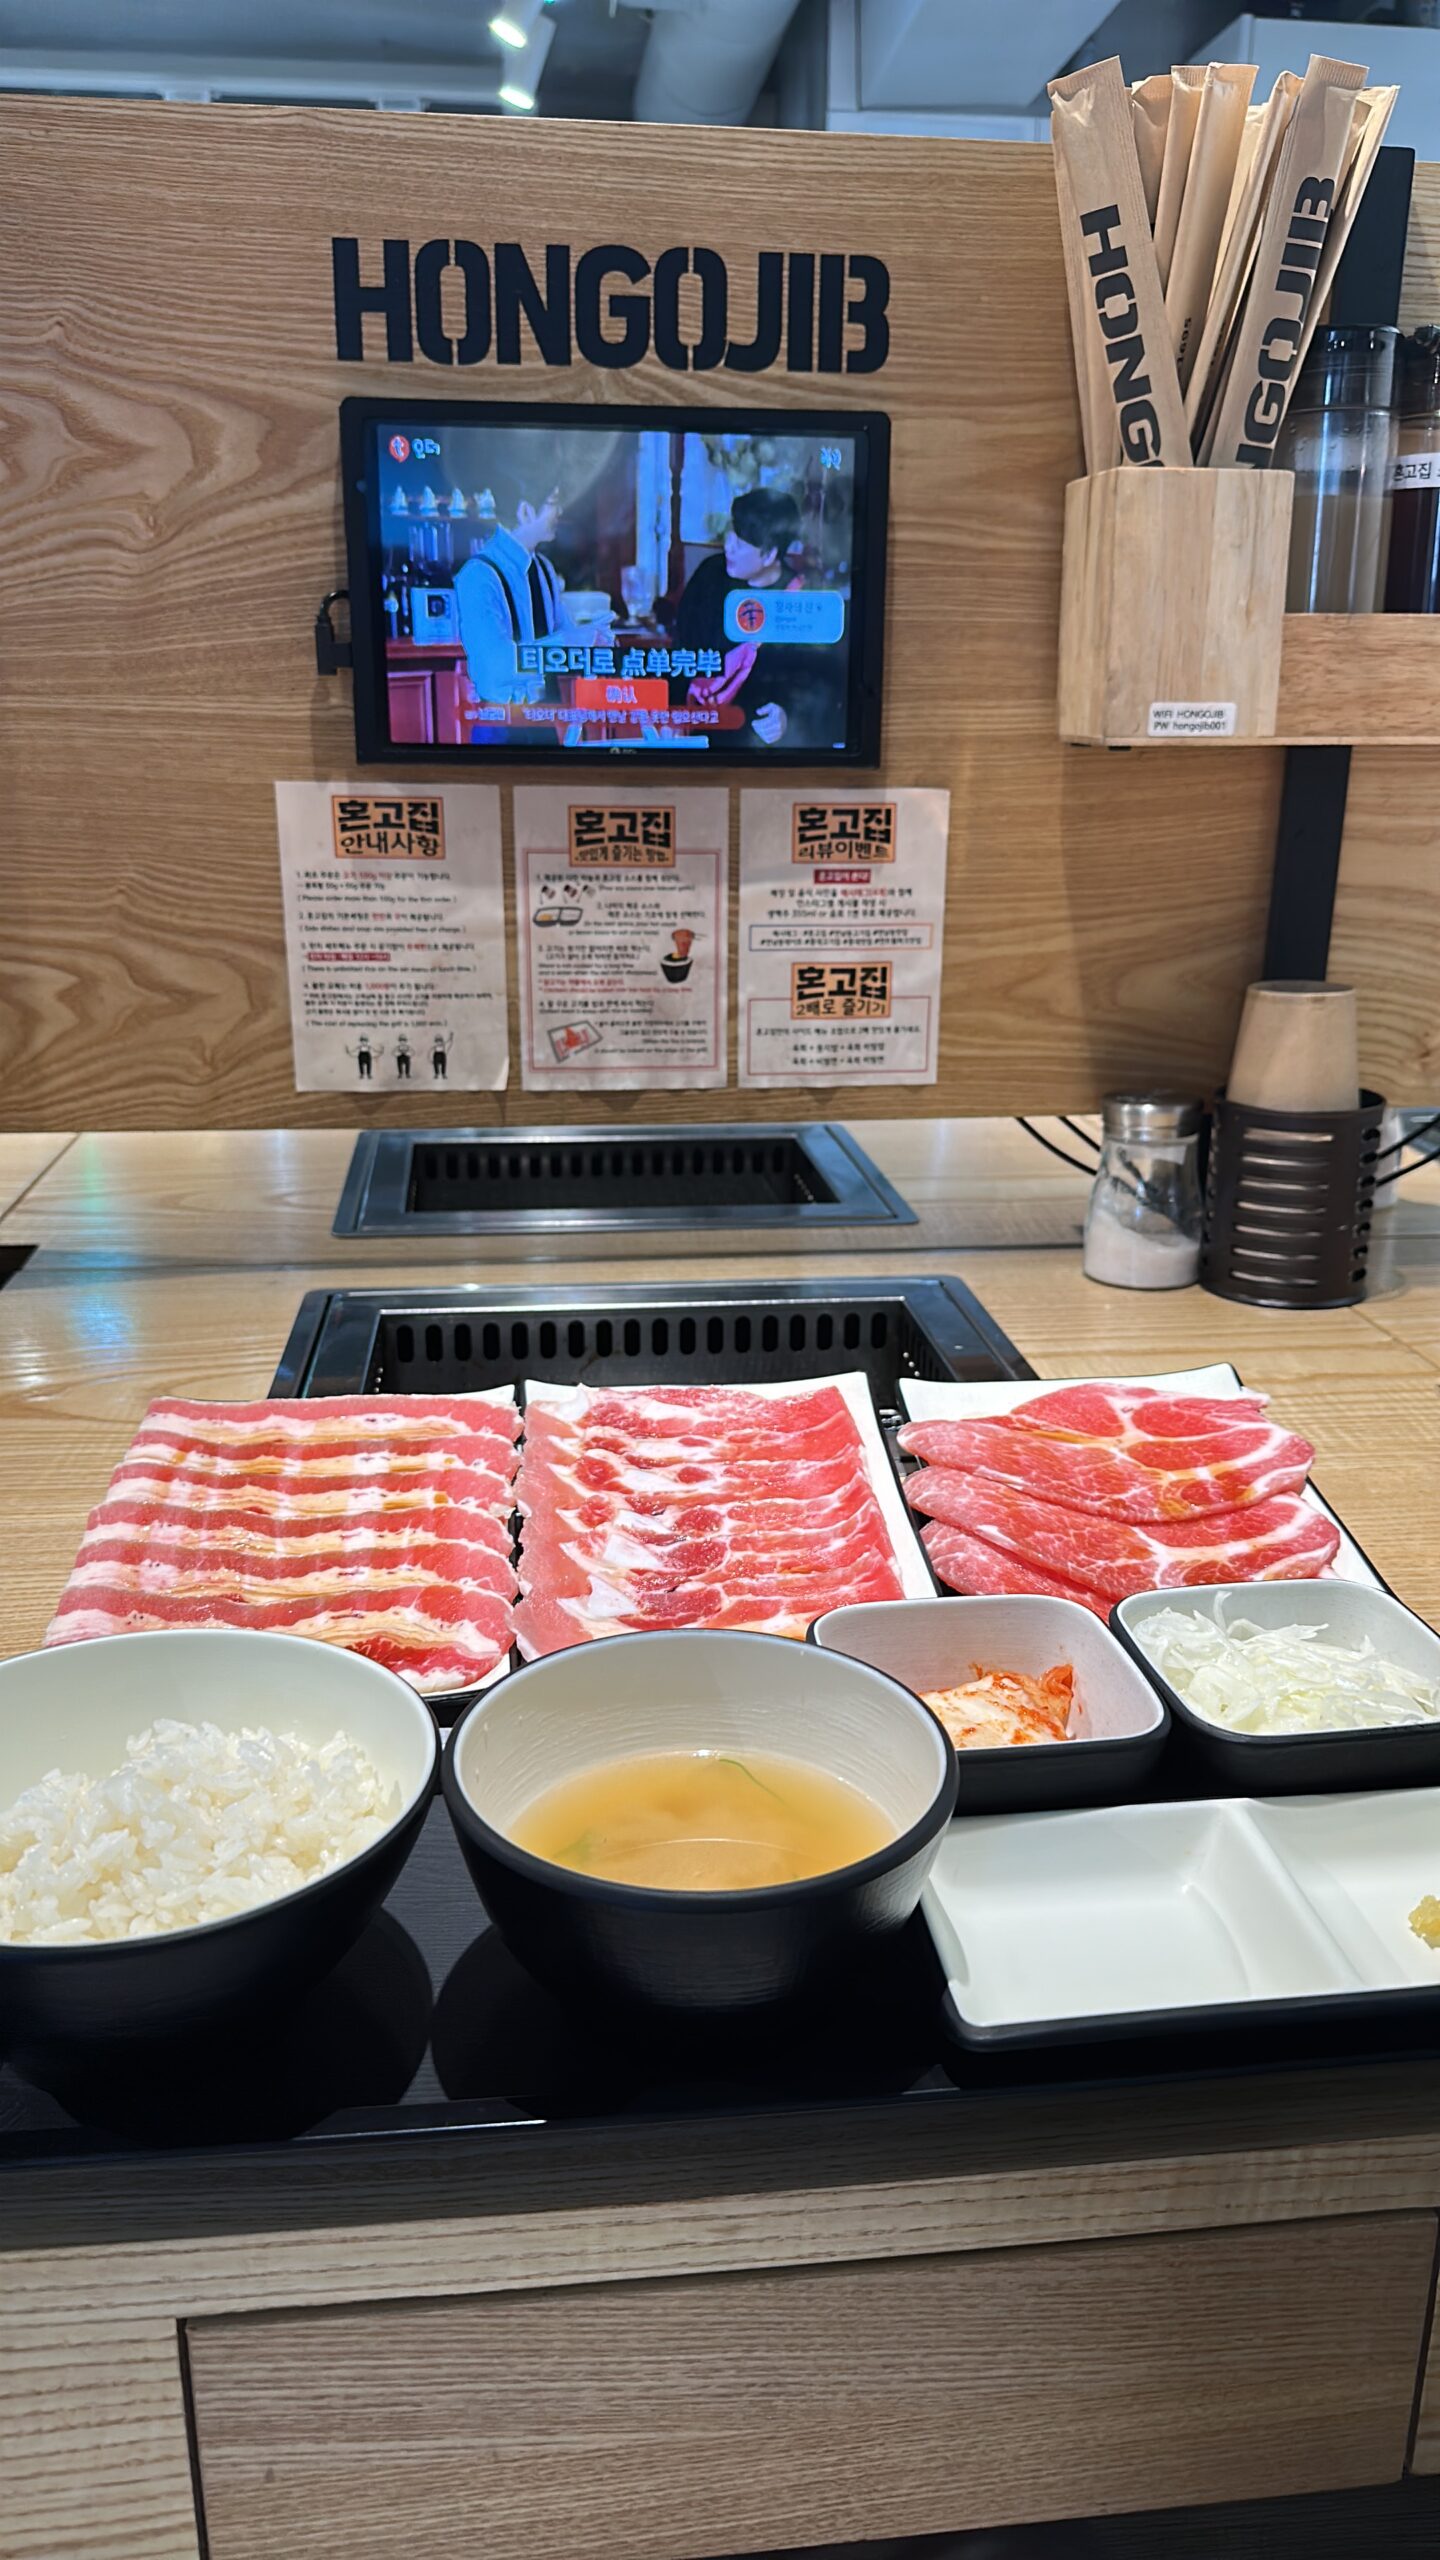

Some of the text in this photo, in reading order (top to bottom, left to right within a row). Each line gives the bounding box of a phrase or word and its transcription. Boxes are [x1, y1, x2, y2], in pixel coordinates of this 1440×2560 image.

[332, 237, 891, 373] HONGOJIB
[1080, 204, 1165, 467] HONG
[521, 647, 722, 677] 티오더로 点单完毕
[338, 800, 439, 835] 혼고집
[574, 810, 671, 848] 혼고집
[797, 808, 892, 844] 혼고집
[341, 831, 440, 857] 안내사항
[798, 840, 890, 860] 리뷰이벤트
[796, 967, 888, 1001] 혼고집
[796, 998, 886, 1016] 2배로 즐기기
